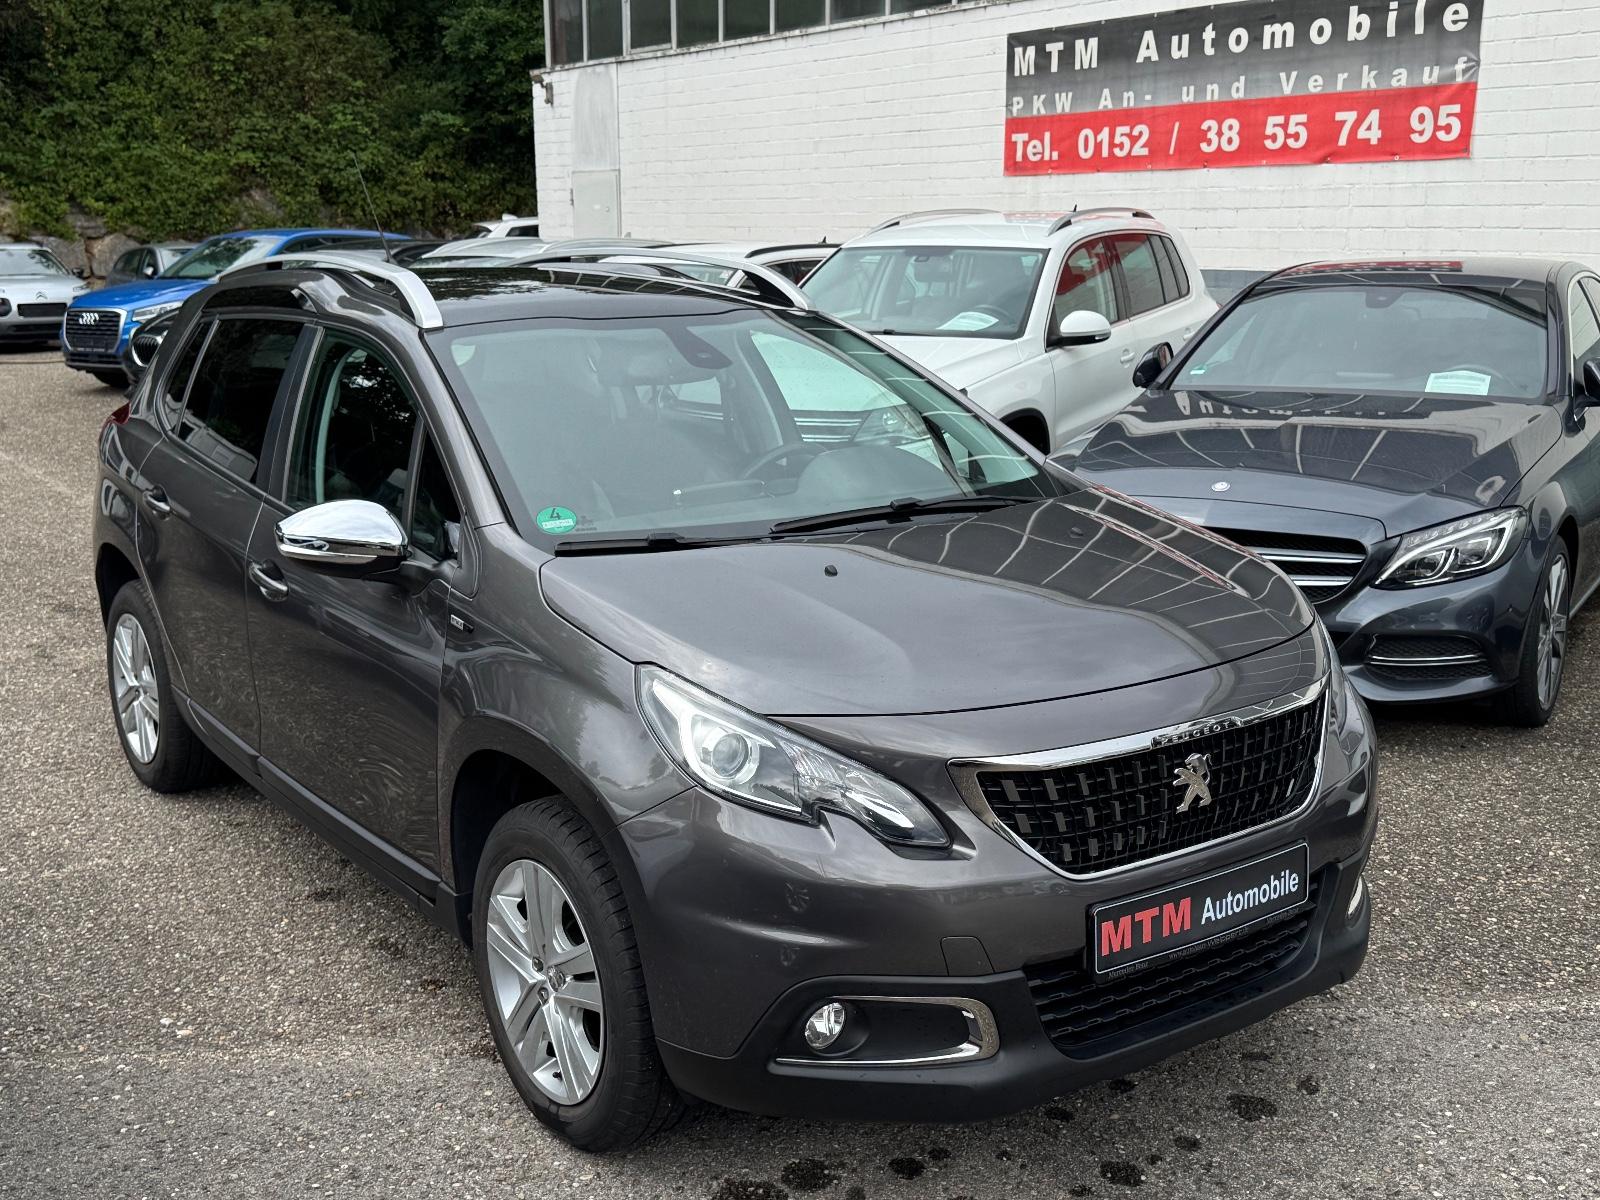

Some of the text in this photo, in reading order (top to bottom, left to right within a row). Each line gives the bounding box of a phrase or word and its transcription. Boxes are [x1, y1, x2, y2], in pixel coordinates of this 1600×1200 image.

[1014, 0, 1469, 76] MTM Automobile
[1012, 57, 1468, 116] PKW An- und Verkauf
[1012, 104, 1461, 162] Tel. 0152 / 38 55 74 95
[550, 507, 561, 520] 4
[1101, 897, 1192, 957] MTM
[1201, 869, 1299, 925] Automobile
